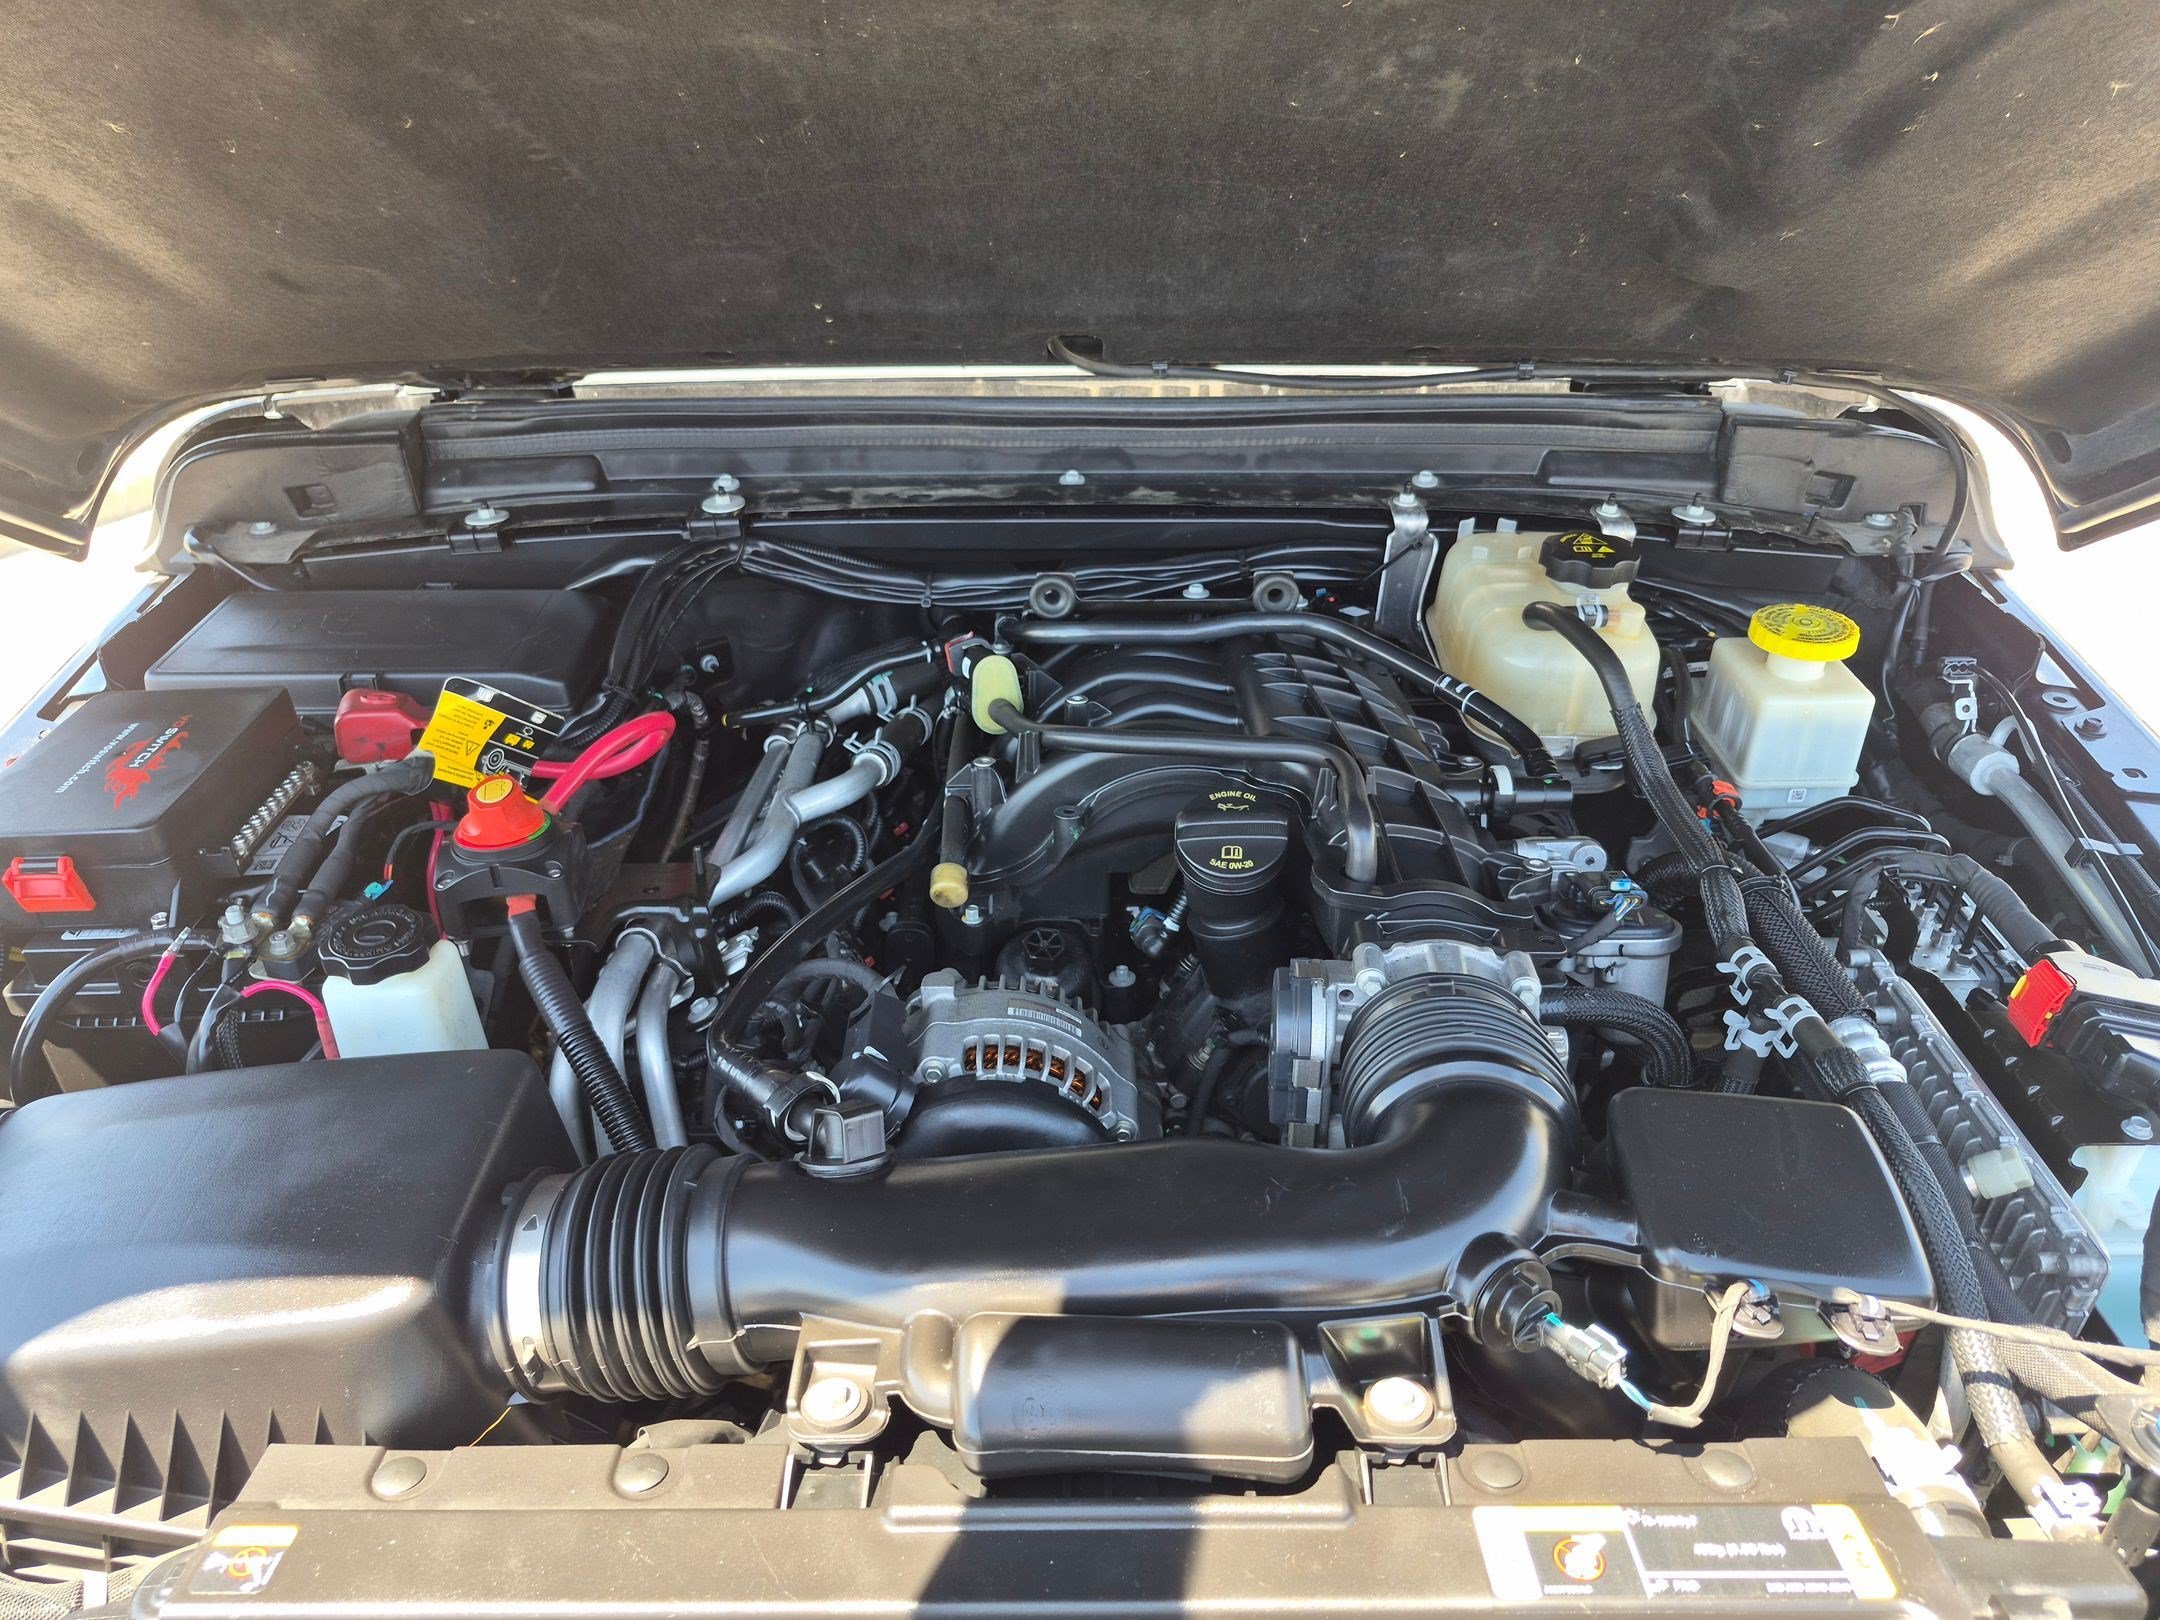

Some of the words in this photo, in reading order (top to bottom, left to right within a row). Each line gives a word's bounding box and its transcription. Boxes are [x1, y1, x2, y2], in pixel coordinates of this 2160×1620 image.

[129, 714, 193, 768] VOSWITCH
[56, 723, 140, 793] www.voswitch.com
[1209, 791, 1242, 800] ENGINE
[1243, 792, 1257, 802] OIL
[1210, 859, 1227, 869] SAE
[1229, 860, 1253, 869] 0W-20
